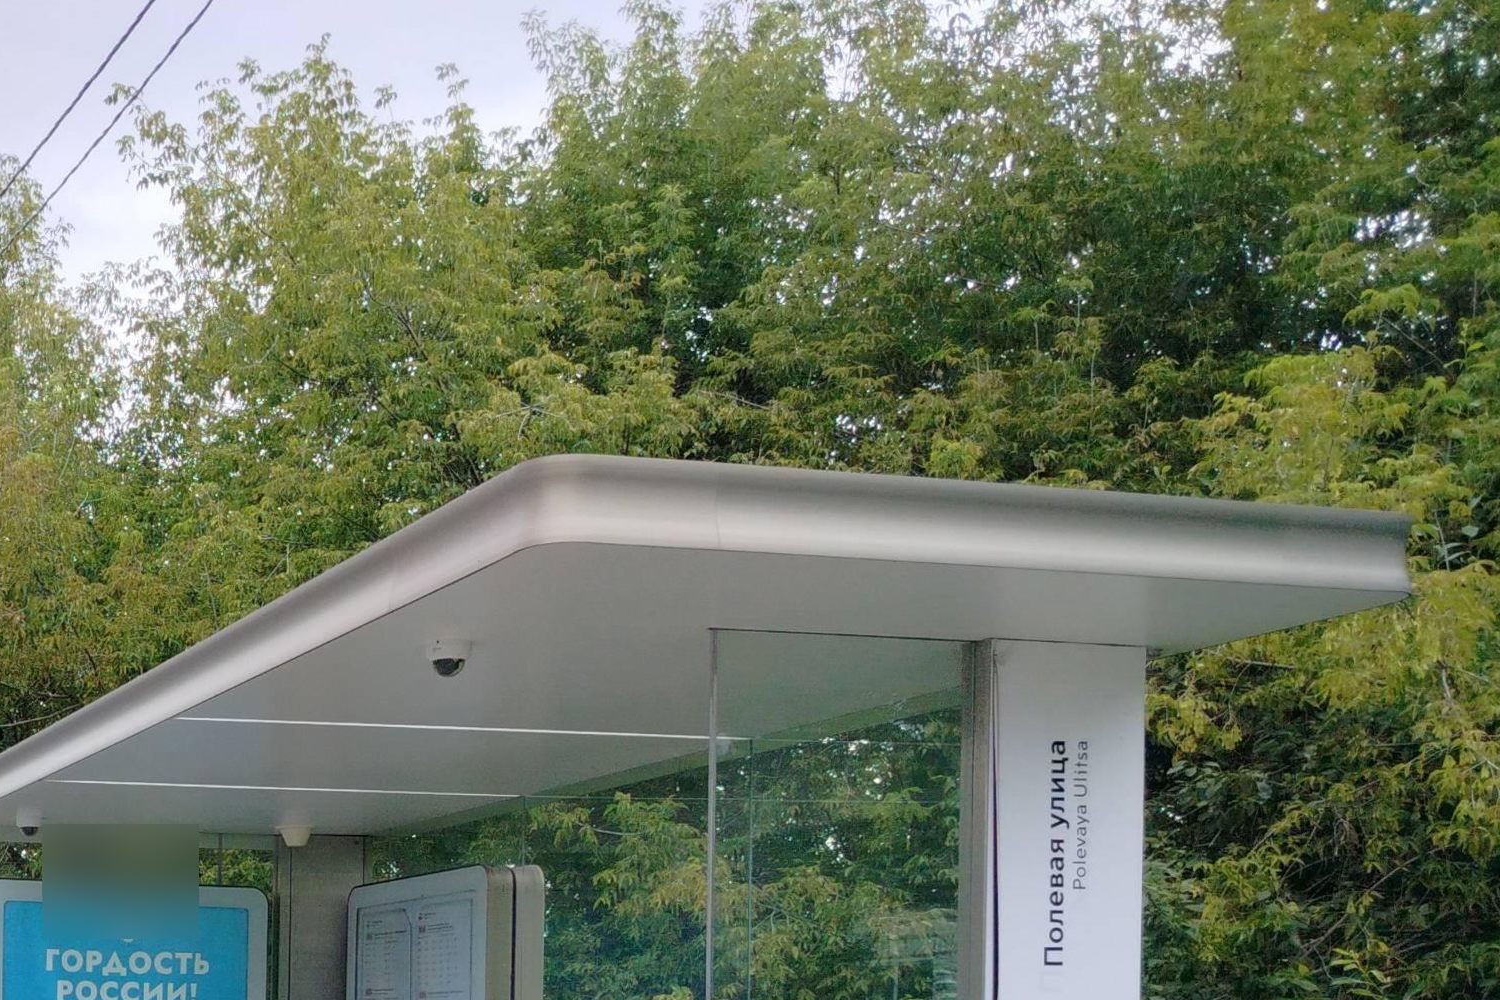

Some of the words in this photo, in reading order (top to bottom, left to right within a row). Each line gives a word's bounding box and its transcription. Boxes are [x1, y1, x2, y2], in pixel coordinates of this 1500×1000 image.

[1050, 741, 1069, 829] улица
[1073, 741, 1088, 798] Ulitsa
[1073, 805, 1090, 890] Polevaya
[1044, 839, 1065, 966] Полевая
[46, 949, 210, 976] ГОРДОСТЬ
